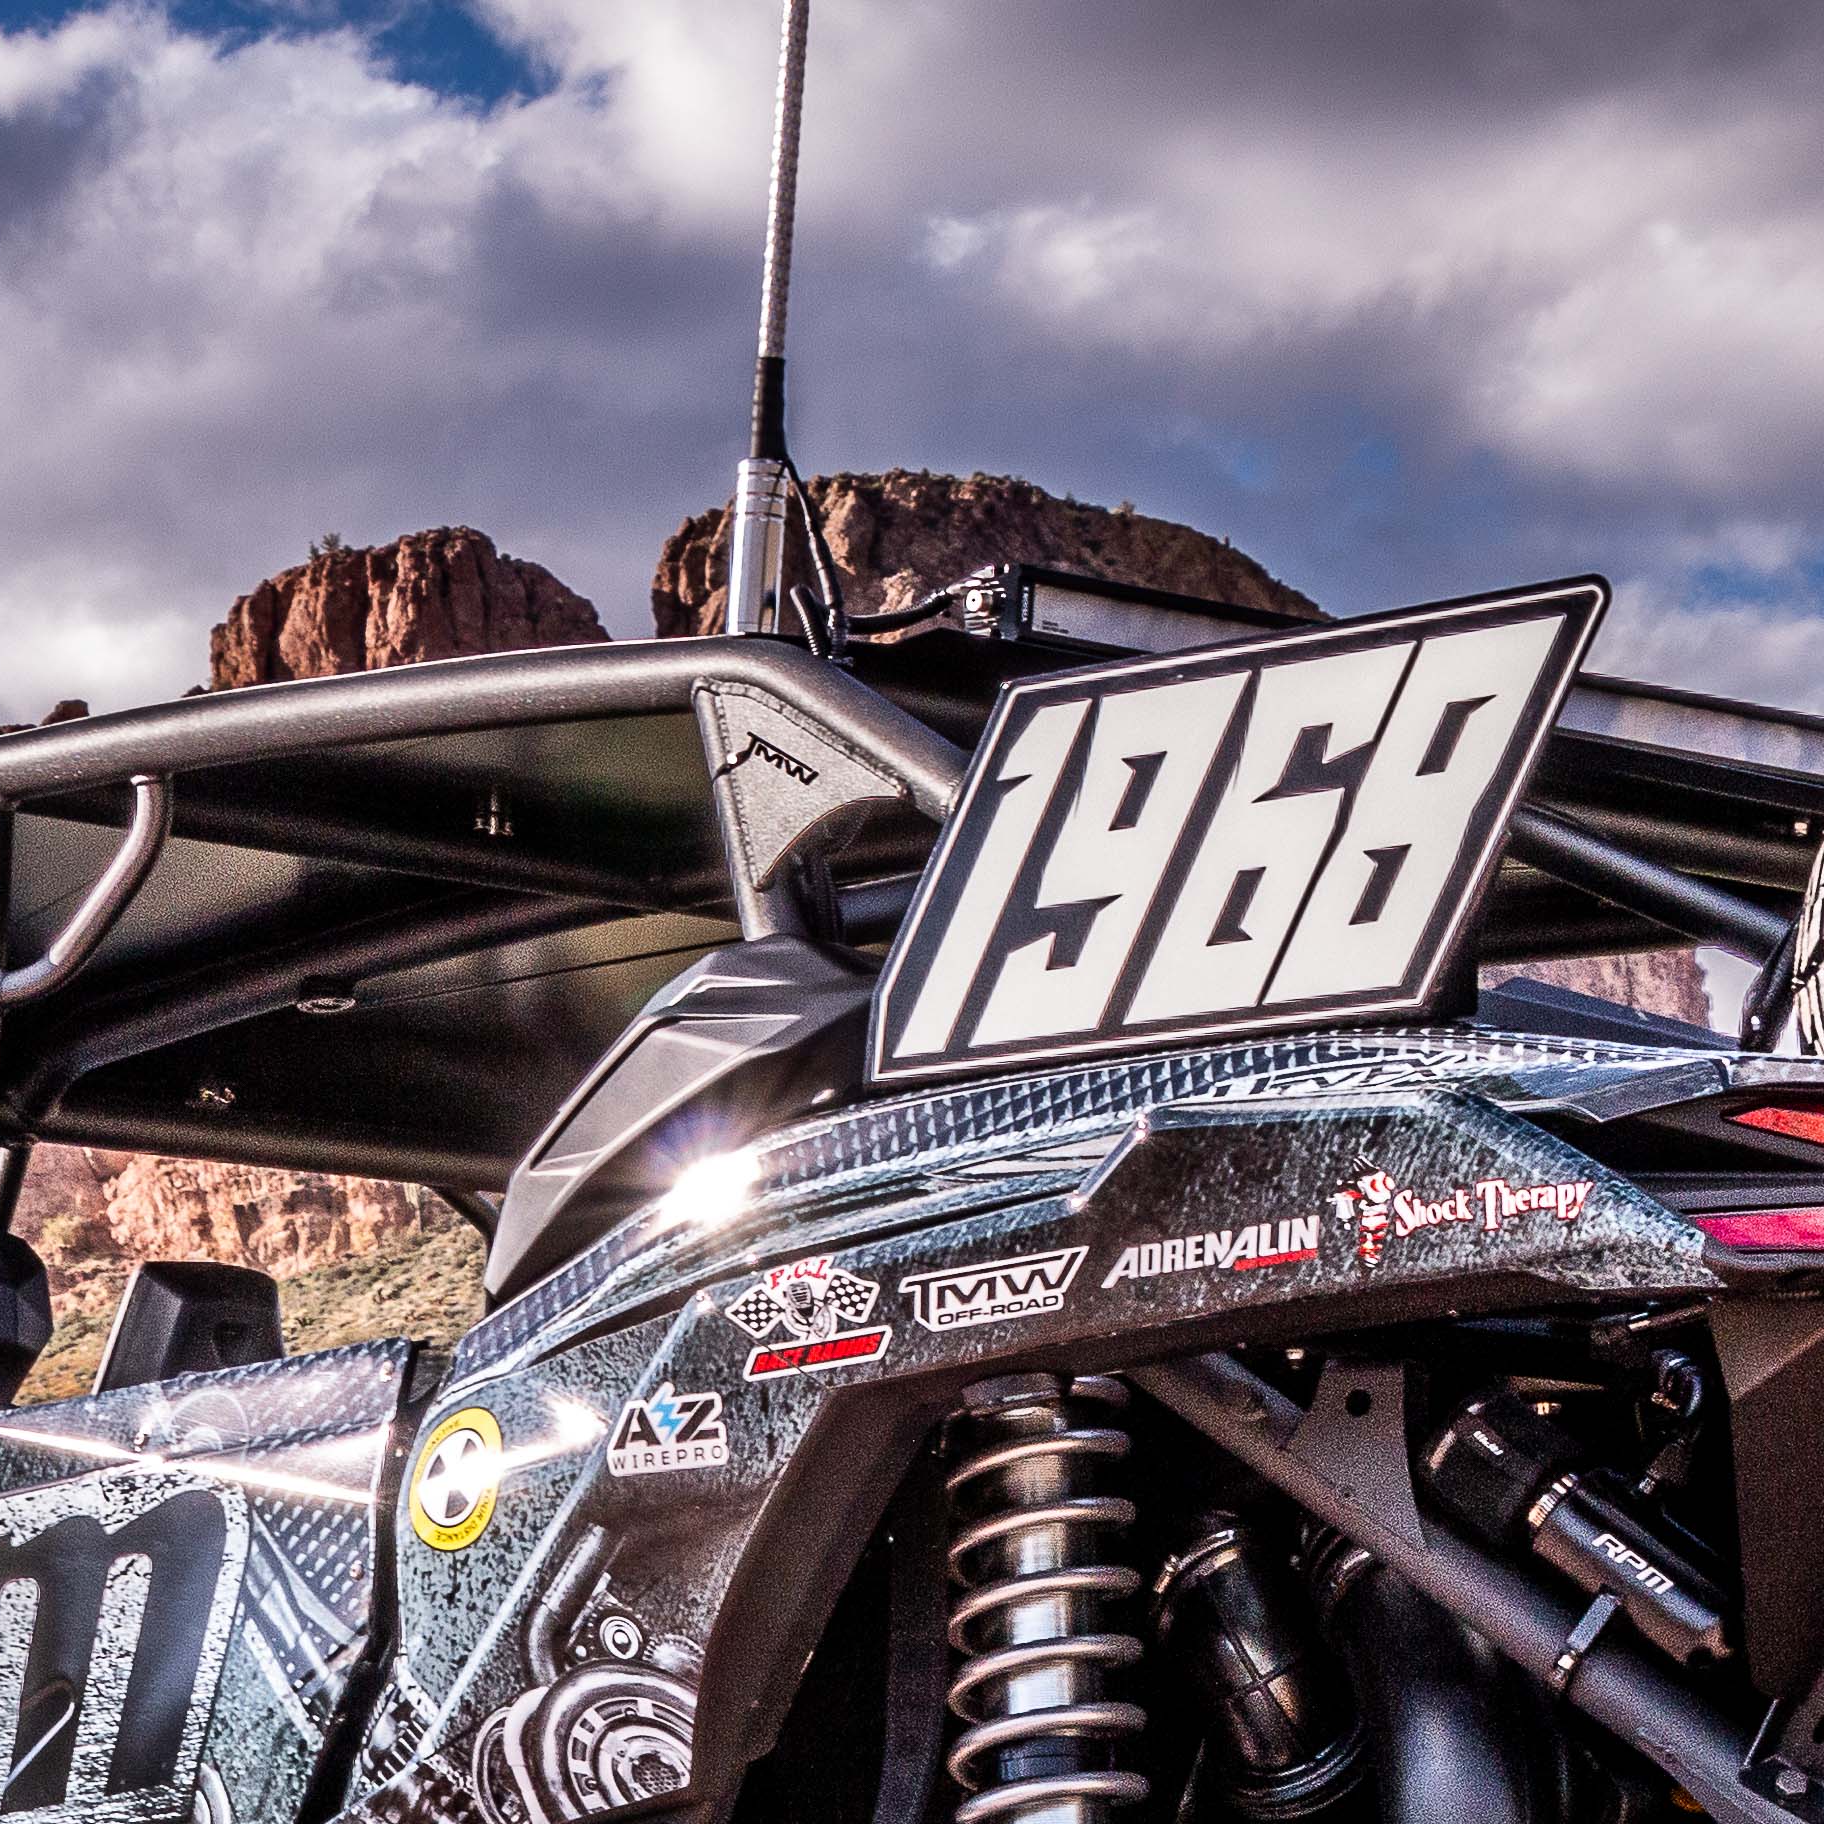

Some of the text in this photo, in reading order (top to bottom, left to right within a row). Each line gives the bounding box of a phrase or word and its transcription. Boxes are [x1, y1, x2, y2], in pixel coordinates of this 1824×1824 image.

[742, 731, 820, 786] TMW
[897, 612, 1569, 1058] 1968
[1393, 1178, 1595, 1238] Shock Therapy
[1100, 1214, 1321, 1290] ADRENALIN
[904, 1253, 1081, 1326] TMW
[937, 1293, 1060, 1325] OFF-ROAD
[611, 1443, 729, 1472] WIREPRO
[1591, 1532, 1675, 1595] RPM
